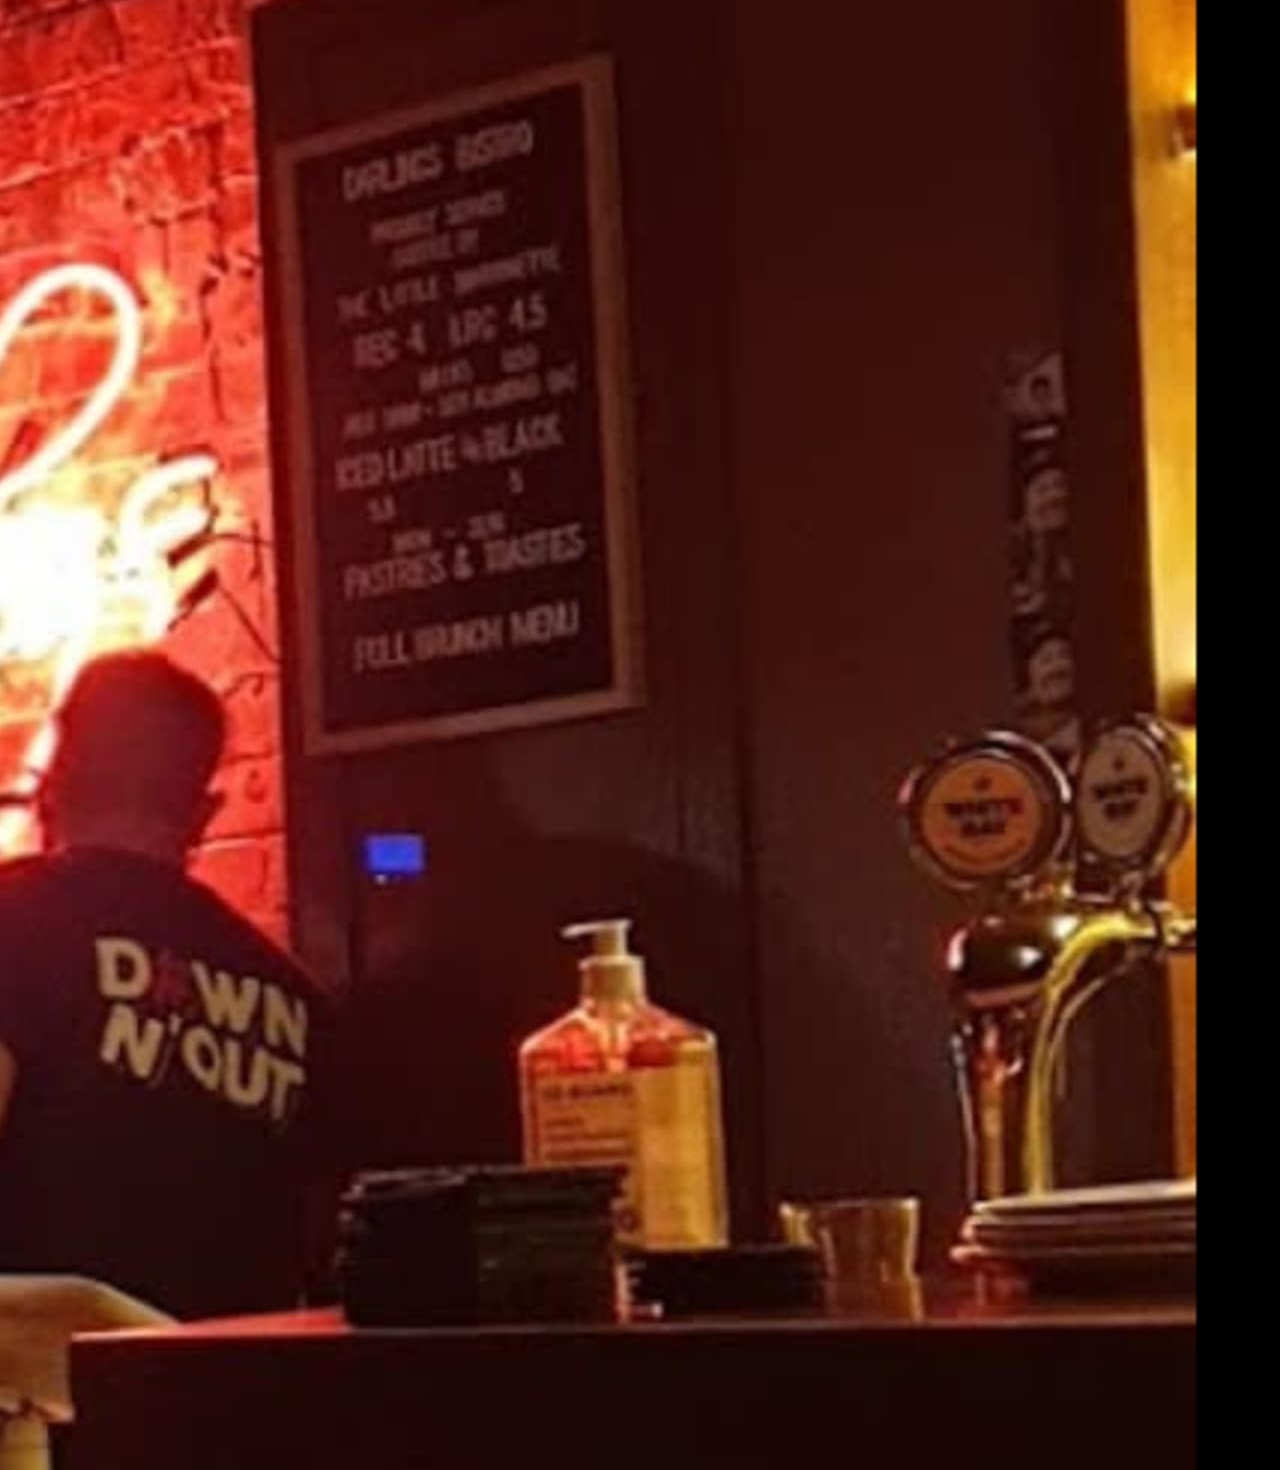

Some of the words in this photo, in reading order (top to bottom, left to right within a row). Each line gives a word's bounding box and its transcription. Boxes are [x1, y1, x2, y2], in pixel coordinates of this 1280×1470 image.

[388, 433, 457, 481] LATTE
[483, 413, 564, 462] BLACK
[510, 601, 579, 648] MENU
[101, 1003, 307, 1122] N'OUT
